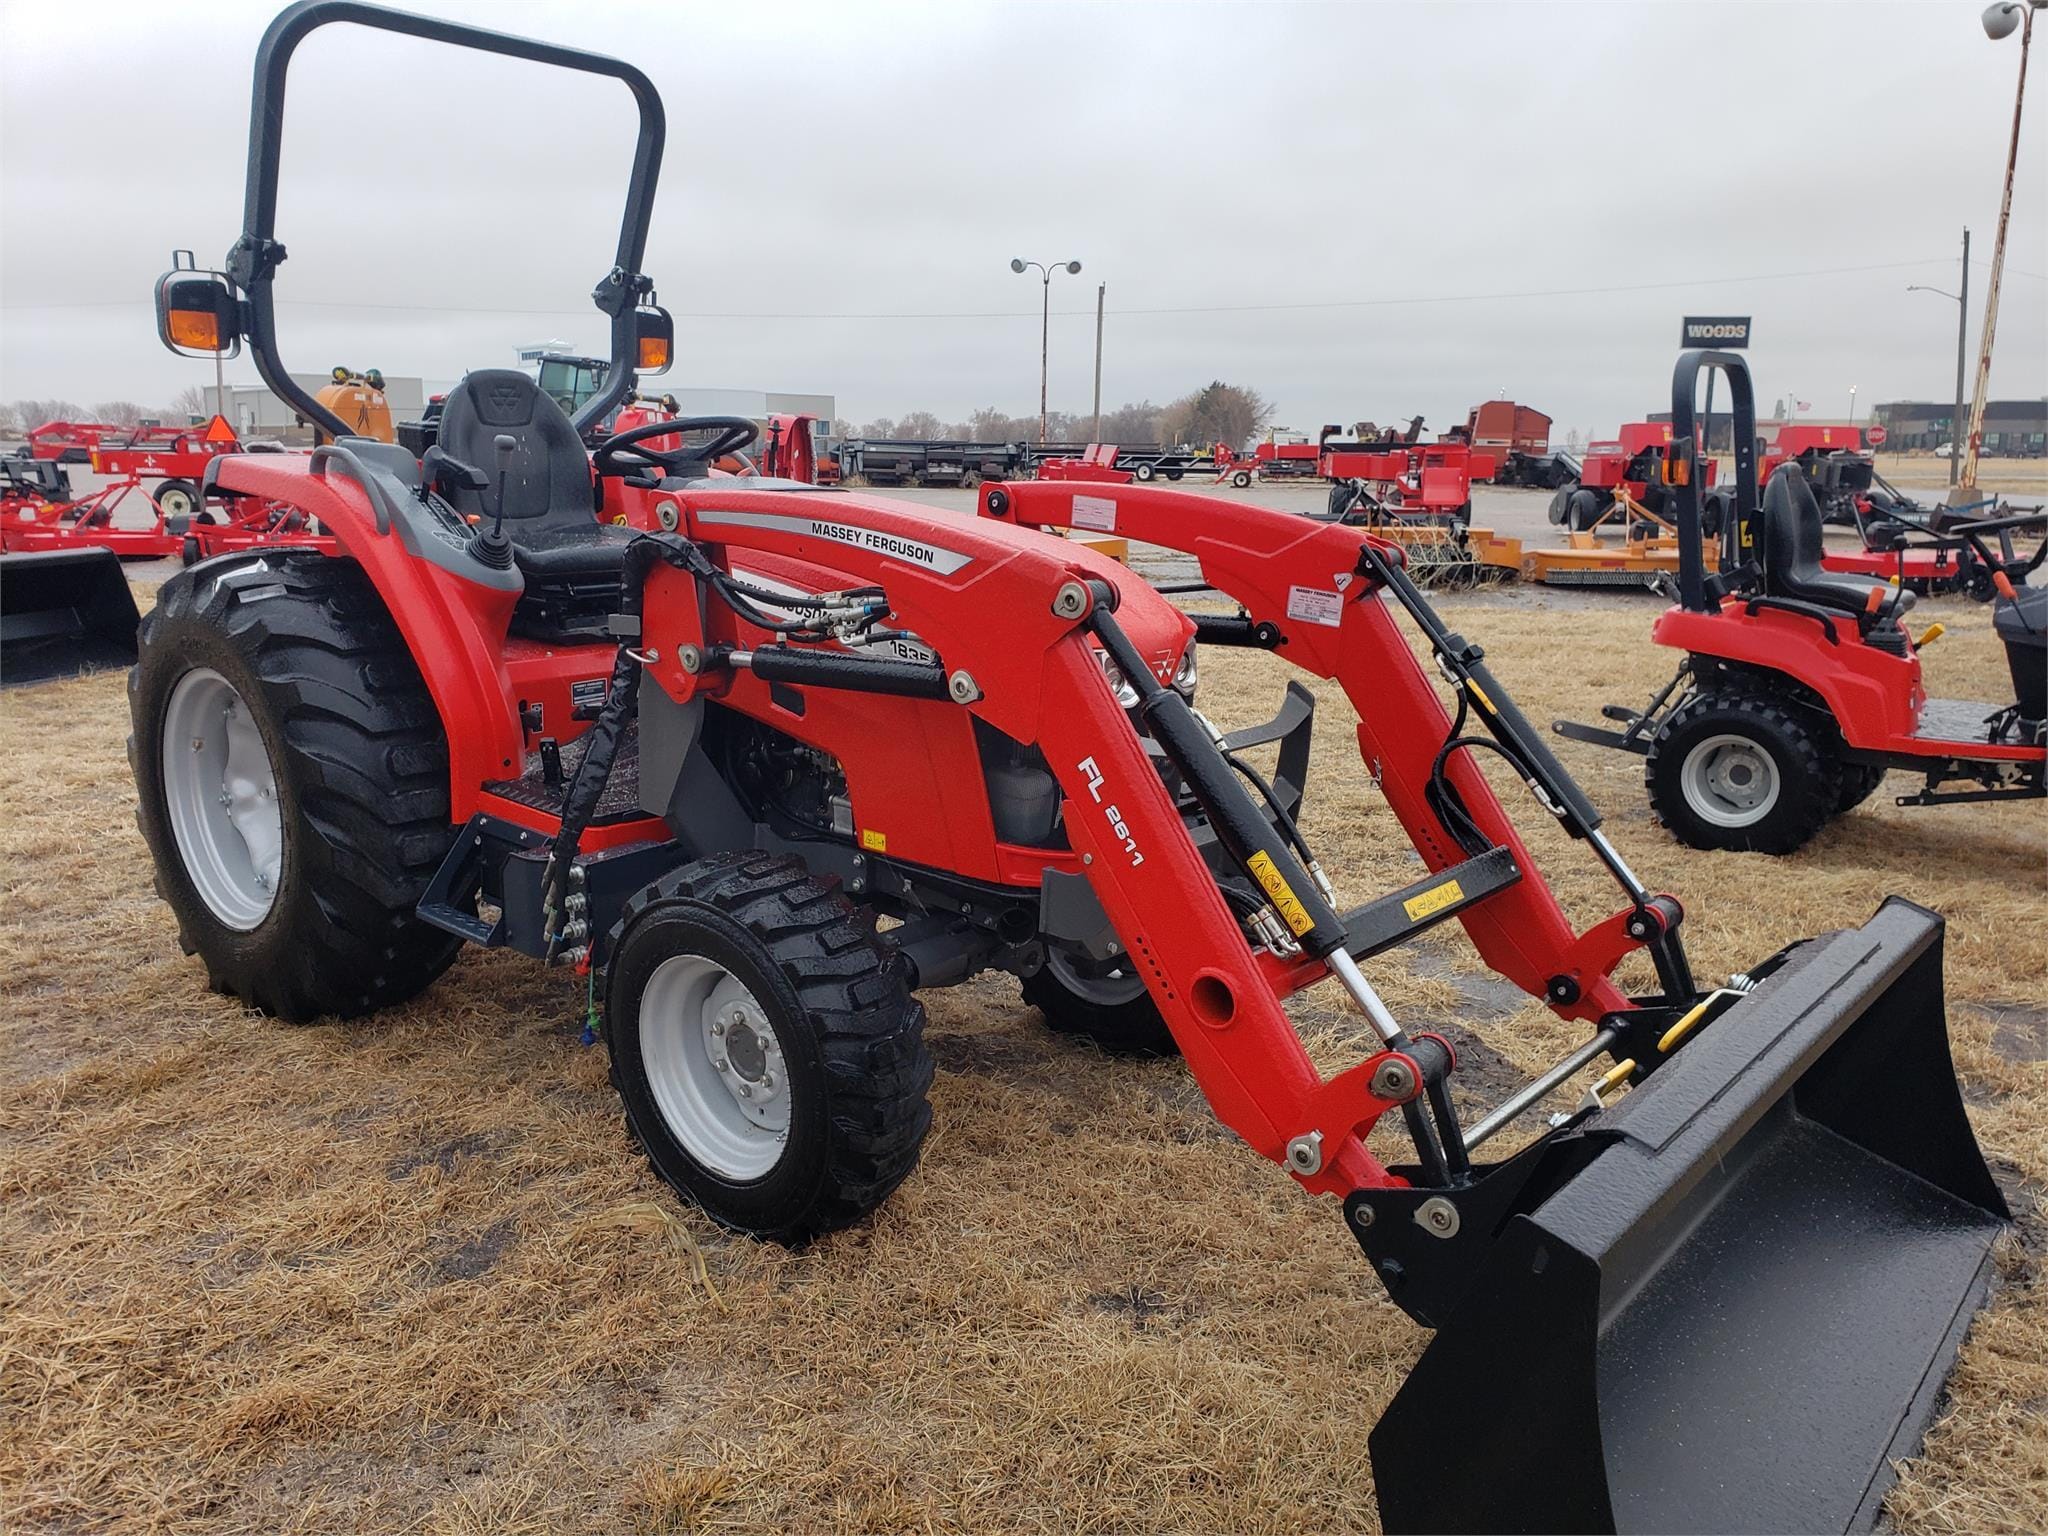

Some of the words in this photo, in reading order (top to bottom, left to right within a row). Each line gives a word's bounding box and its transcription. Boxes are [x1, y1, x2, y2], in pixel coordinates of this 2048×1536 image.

[1688, 324, 1746, 338] WOODS
[1868, 430, 1885, 440] STOP
[811, 522, 862, 544] MASSEY
[865, 533, 934, 564] FERGUSON
[1077, 756, 1105, 804] FL
[1105, 805, 1145, 866] 2611
